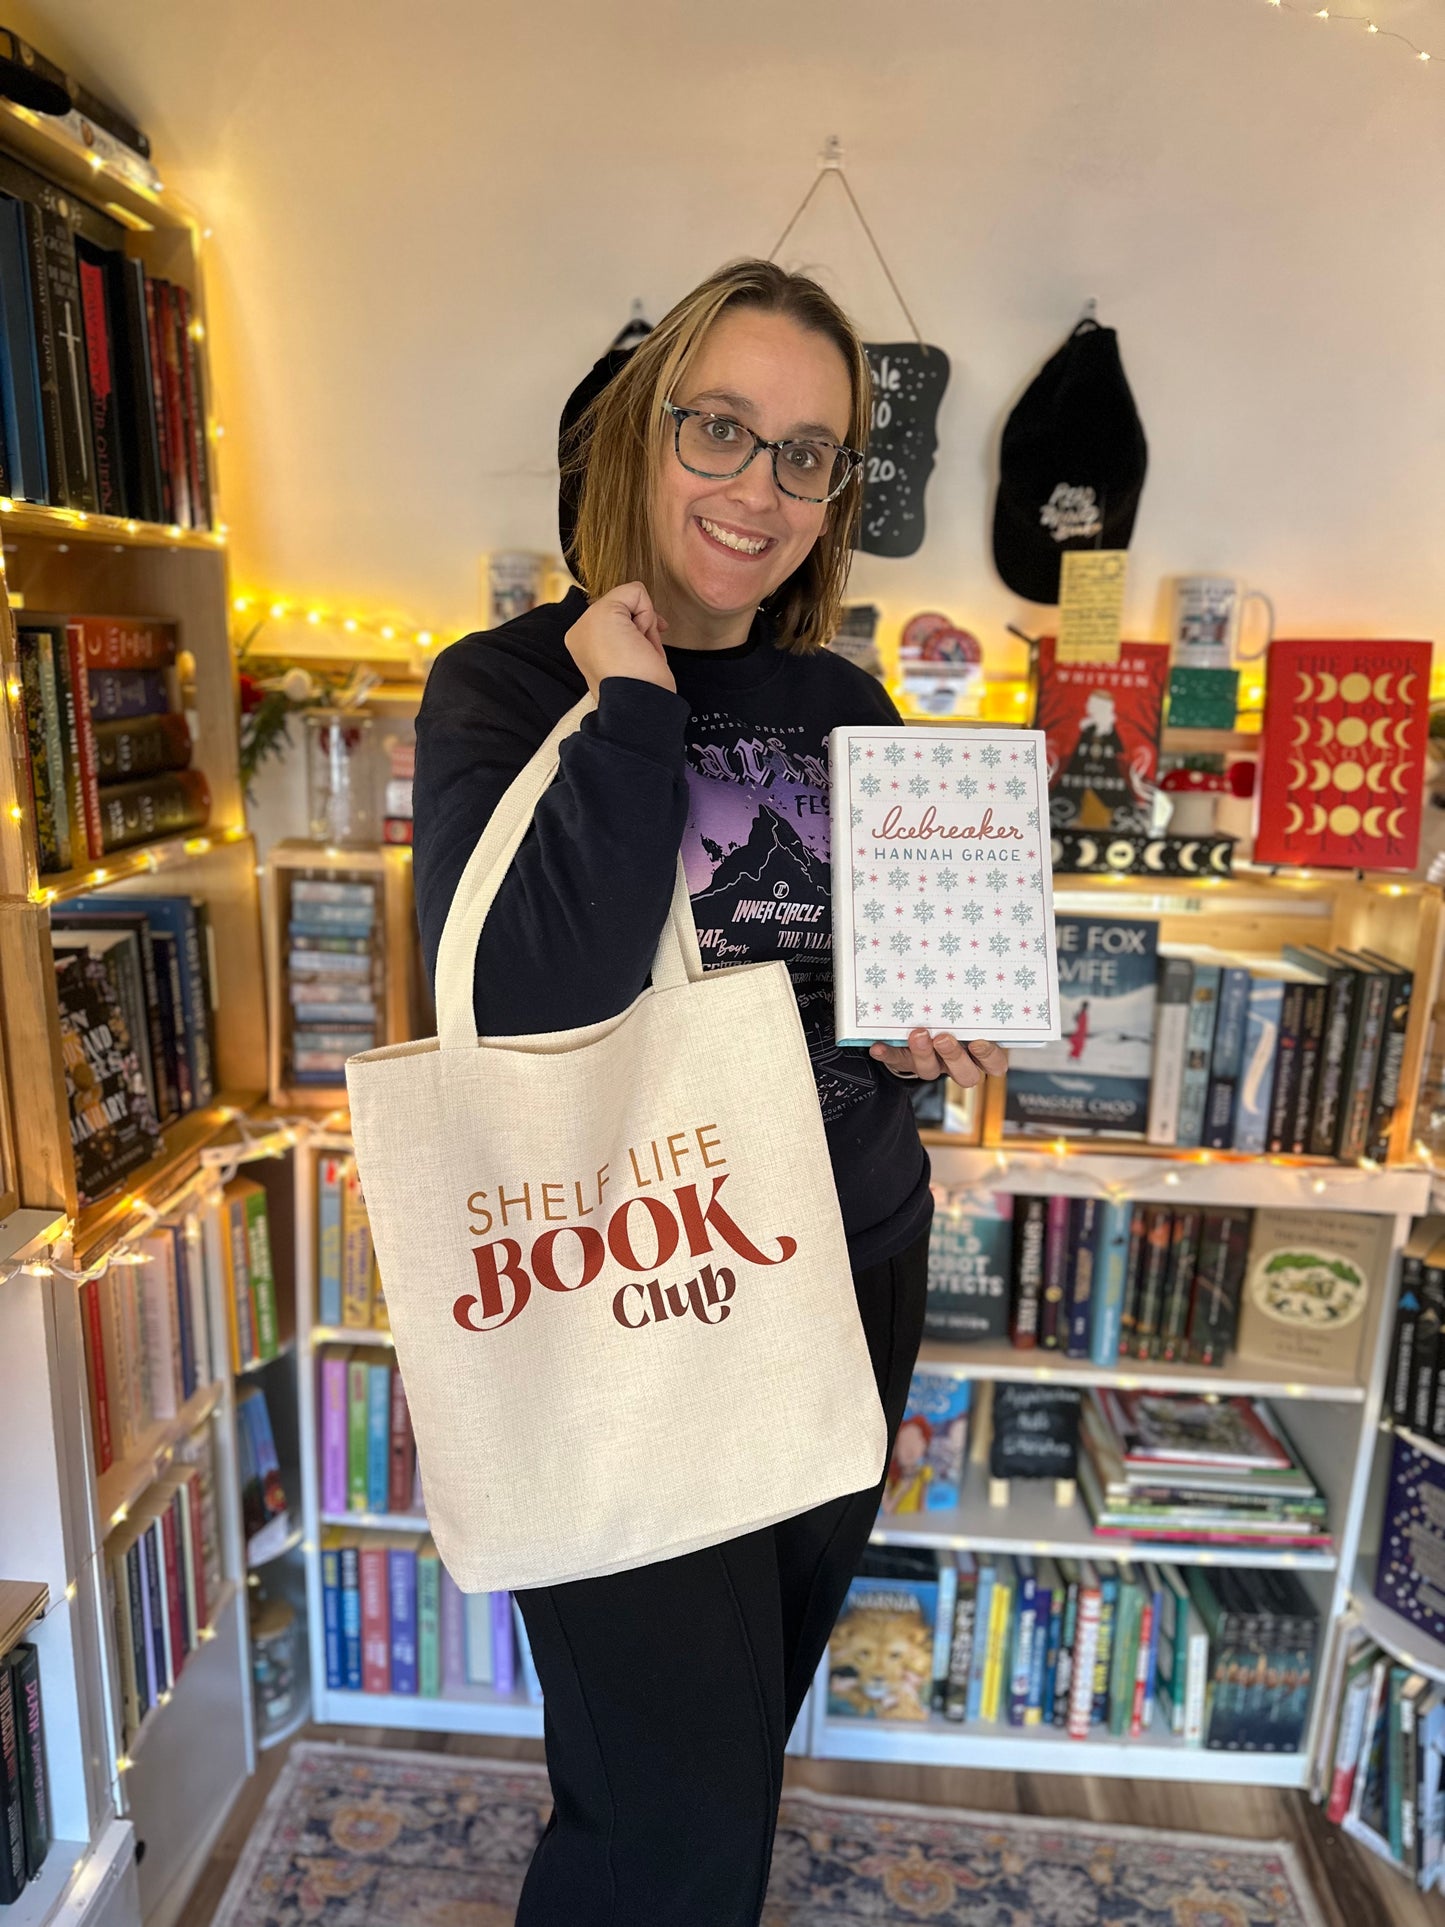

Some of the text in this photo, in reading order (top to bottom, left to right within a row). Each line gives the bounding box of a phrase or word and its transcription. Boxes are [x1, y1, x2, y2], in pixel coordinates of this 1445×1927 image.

[43, 334, 55, 373] LIARS
[96, 436, 114, 509] QUEEN
[867, 457, 896, 484] 20
[1296, 655, 1418, 677] THE BOOK
[1055, 672, 1150, 688] WHITTEN
[1342, 701, 1417, 719] LOVE
[691, 712, 805, 735] OURT DREAMS
[83, 719, 95, 776] AMONG
[1078, 743, 1115, 759] FOR
[1061, 775, 1125, 792] THRONE
[795, 794, 830, 818] FES
[872, 805, 1024, 841] Icebreaker
[874, 847, 1022, 862] HANNAH GRACE
[1283, 834, 1402, 857] LINK
[731, 899, 825, 925] INNER CIRCLE
[185, 927, 200, 972] LOST
[716, 938, 750, 958] Boys
[777, 930, 832, 950] THE VALK
[1086, 925, 1148, 955] FOX
[189, 978, 203, 1030] STORY
[823, 1103, 846, 1117] COURT
[466, 1123, 727, 1236] SHELF LIFE
[453, 1173, 798, 1332] BOOK
[928, 1254, 991, 1275] OBOT
[1020, 1222, 1043, 1286] SPINDLE
[612, 1263, 736, 1329] Club
[927, 1273, 1004, 1298] OTECTS
[25, 1679, 39, 1733] DEATH
[0, 1689, 15, 1758] HITCHCOCK
